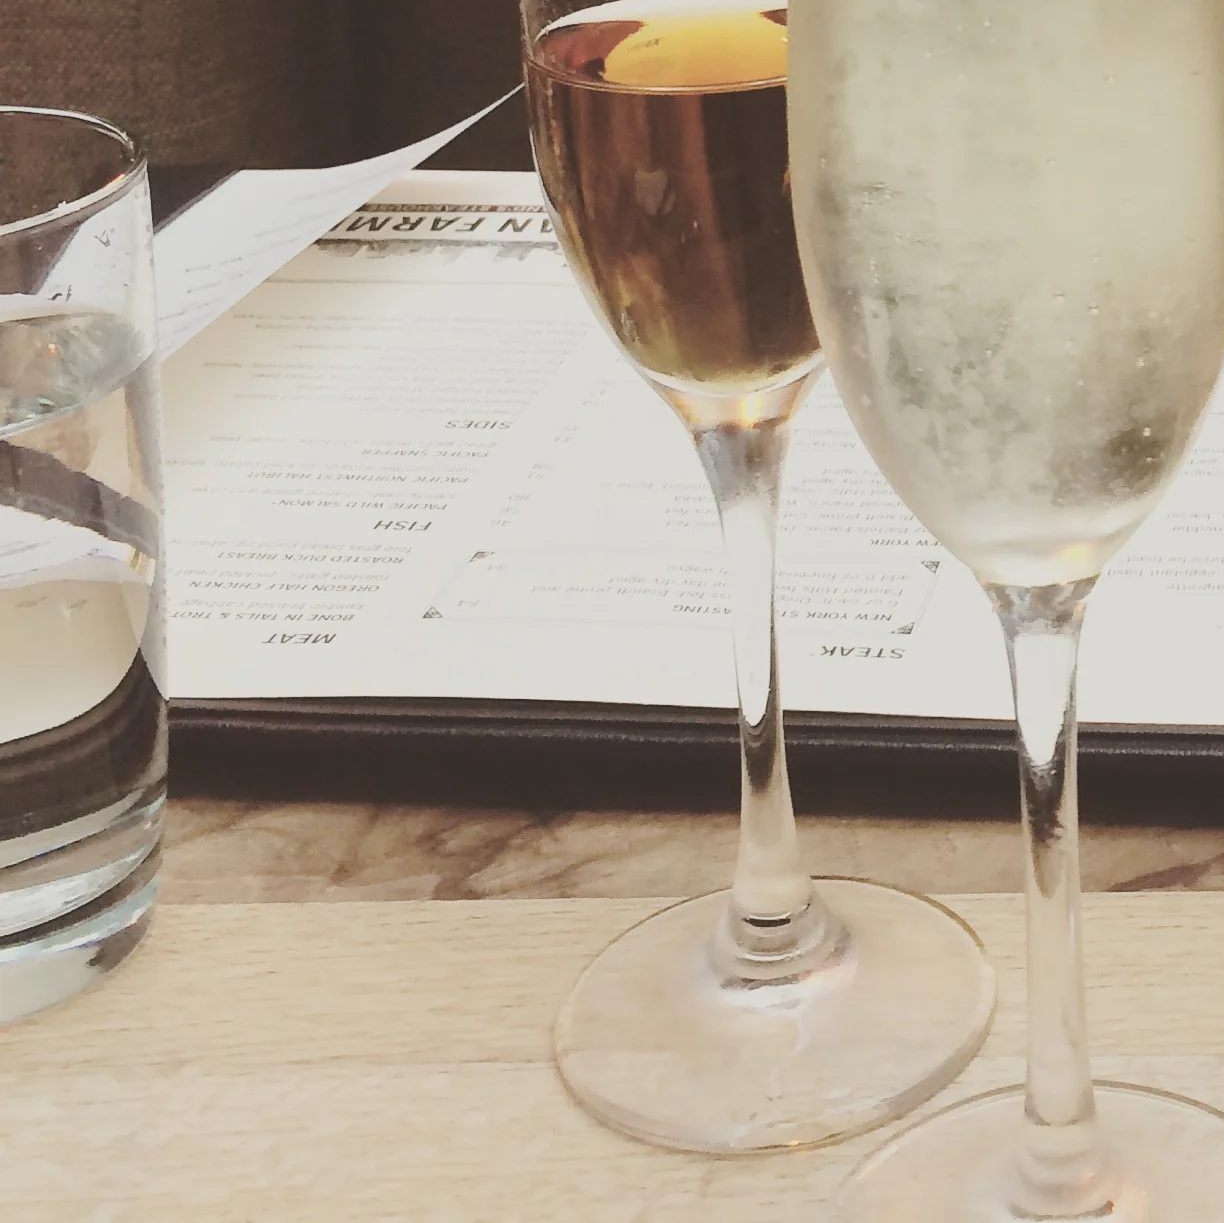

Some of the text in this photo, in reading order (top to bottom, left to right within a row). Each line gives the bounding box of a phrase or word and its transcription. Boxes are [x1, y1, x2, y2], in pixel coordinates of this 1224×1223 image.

[445, 419, 514, 430] SIDES
[432, 450, 490, 459] PACIFIC
[316, 473, 409, 483] NORTHWEST
[411, 475, 470, 485] PACIFIC
[345, 501, 385, 510] WILD
[387, 502, 448, 511] PACIFIC
[372, 520, 433, 532] FISH
[869, 537, 910, 547] YORK
[215, 551, 405, 564] ROASTED DUCK BREAST
[187, 580, 380, 593] OREGON HALF CHICKEN
[672, 604, 733, 615] ASTING
[168, 610, 212, 620] TROT
[234, 612, 279, 621] TAILS
[283, 613, 304, 621] IN
[307, 613, 355, 622] BONE
[805, 611, 849, 621] YORK
[854, 613, 893, 622] NEW
[260, 632, 338, 645] MEAT
